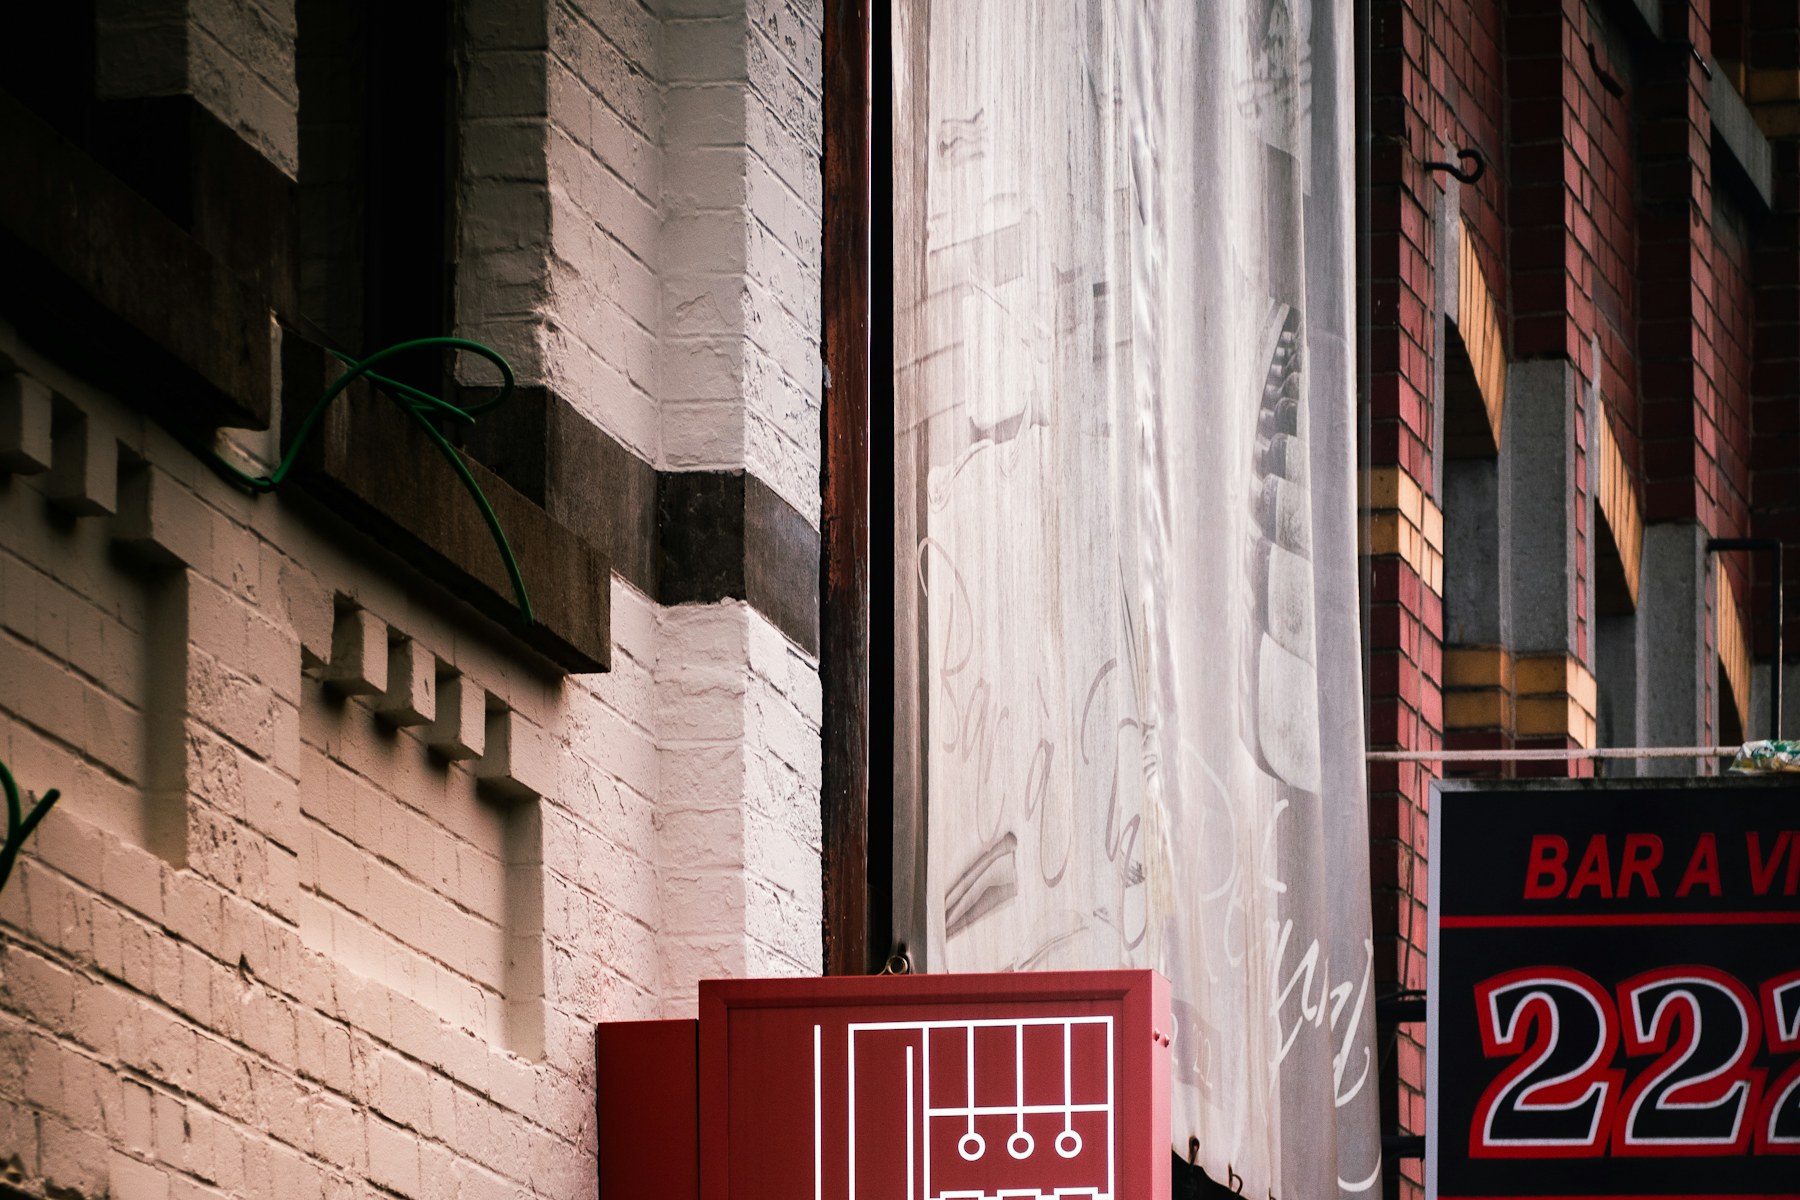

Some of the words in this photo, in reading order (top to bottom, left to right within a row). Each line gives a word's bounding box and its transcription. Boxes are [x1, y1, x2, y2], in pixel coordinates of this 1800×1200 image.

[1523, 832, 1666, 899] BAR
[1675, 831, 1724, 897] A
[1468, 964, 1800, 1159] 22
